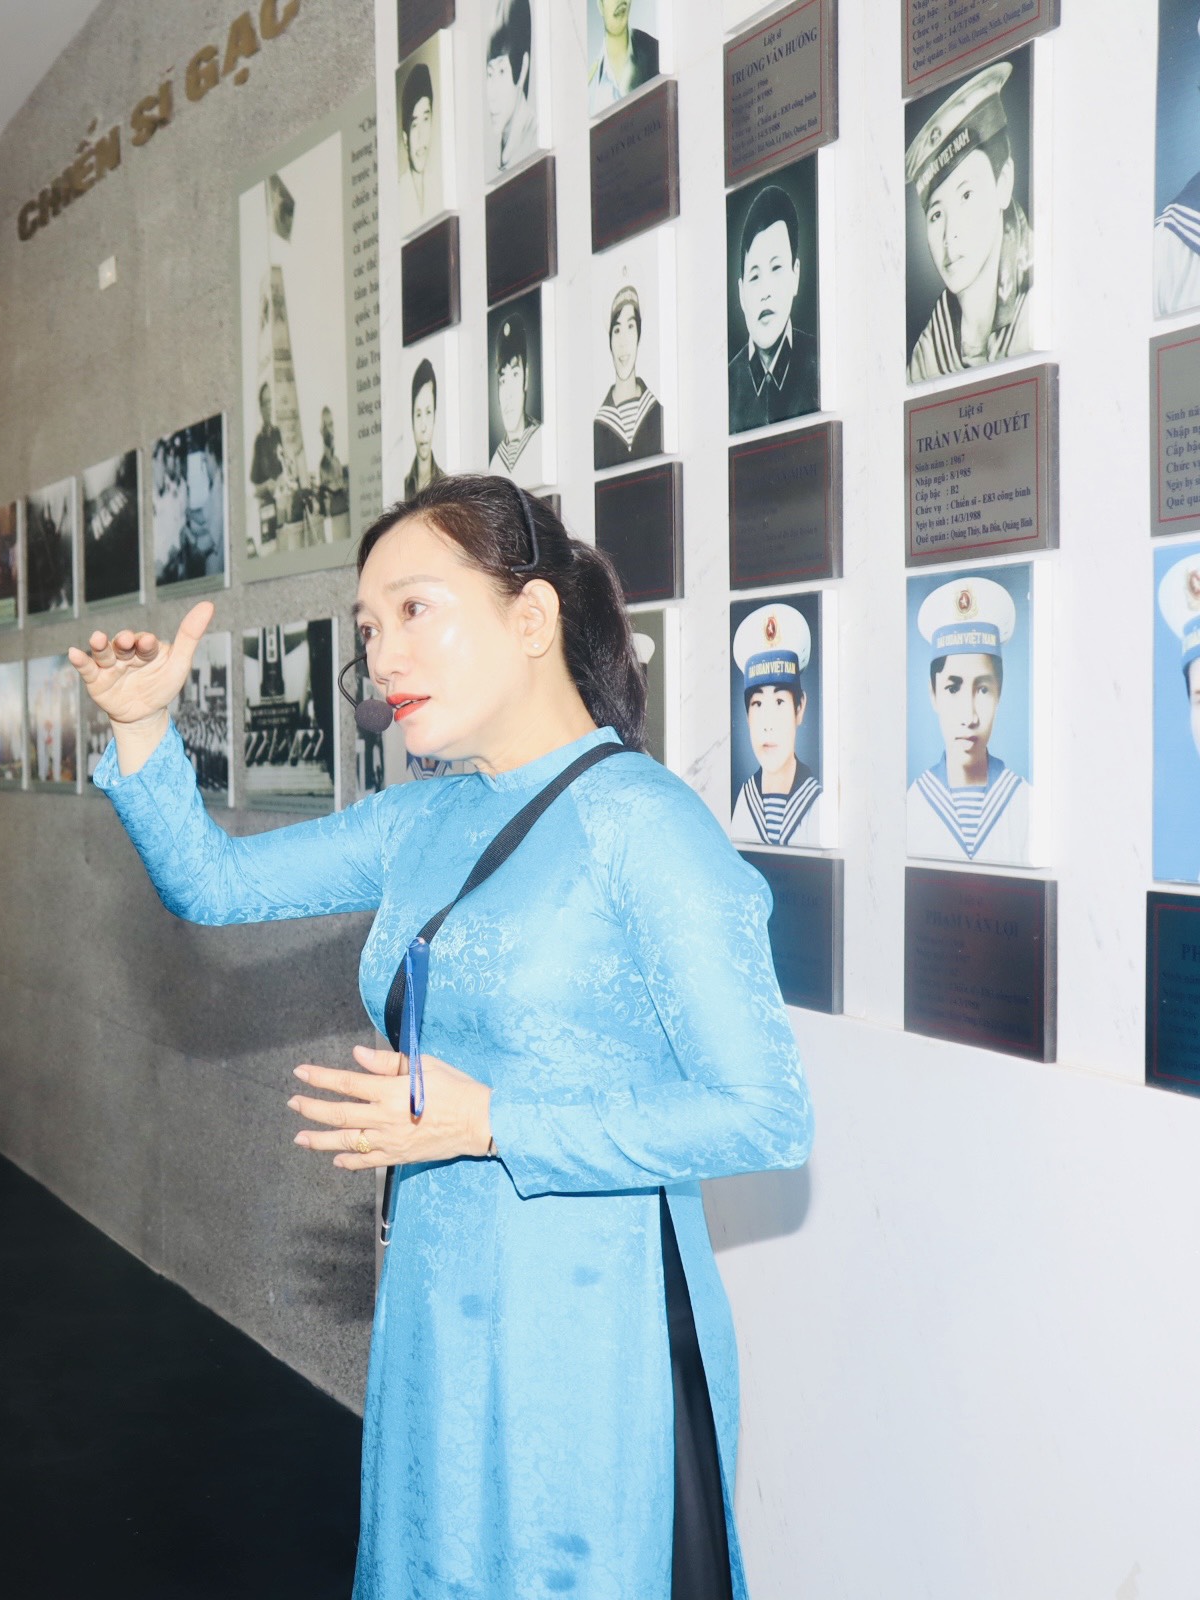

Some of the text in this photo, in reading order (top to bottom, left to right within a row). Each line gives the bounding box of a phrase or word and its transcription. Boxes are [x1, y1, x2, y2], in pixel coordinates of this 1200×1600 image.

[17, 117, 122, 242] CHIẾN
[959, 402, 983, 419] Liệt sĩ
[1166, 405, 1200, 421] Sinh nă
[916, 410, 1030, 453] TRẦN VĂN QUYẾT
[1166, 424, 1190, 440] Nhập
[1166, 441, 1185, 457] Cấp
[950, 453, 965, 465] 1967
[1166, 459, 1190, 474] Chức
[915, 488, 928, 502] Cấp
[930, 488, 941, 500] bậc
[950, 484, 959, 495] B2
[915, 504, 932, 516] Chức
[934, 504, 942, 514] vụ
[950, 495, 970, 509] Chiến
[1166, 494, 1185, 509] Quê
[950, 510, 981, 525] 14/3/1988
[916, 533, 928, 546] Quê
